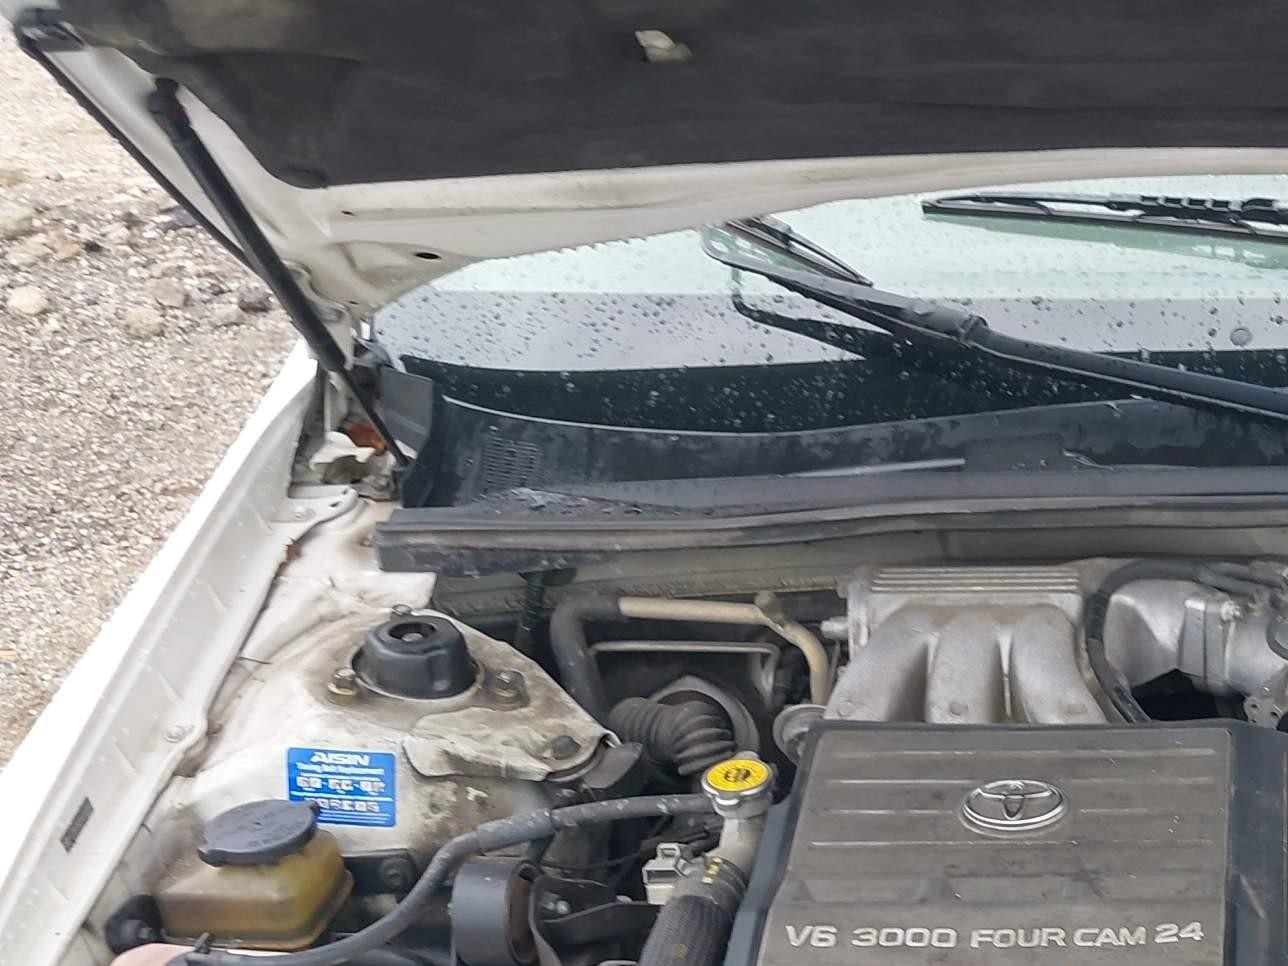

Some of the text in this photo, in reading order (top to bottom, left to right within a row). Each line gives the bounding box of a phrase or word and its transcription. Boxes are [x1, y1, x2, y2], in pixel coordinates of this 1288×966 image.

[310, 751, 370, 766] AISIN
[785, 921, 1205, 949] V6 3000 FOUR CAM 24
